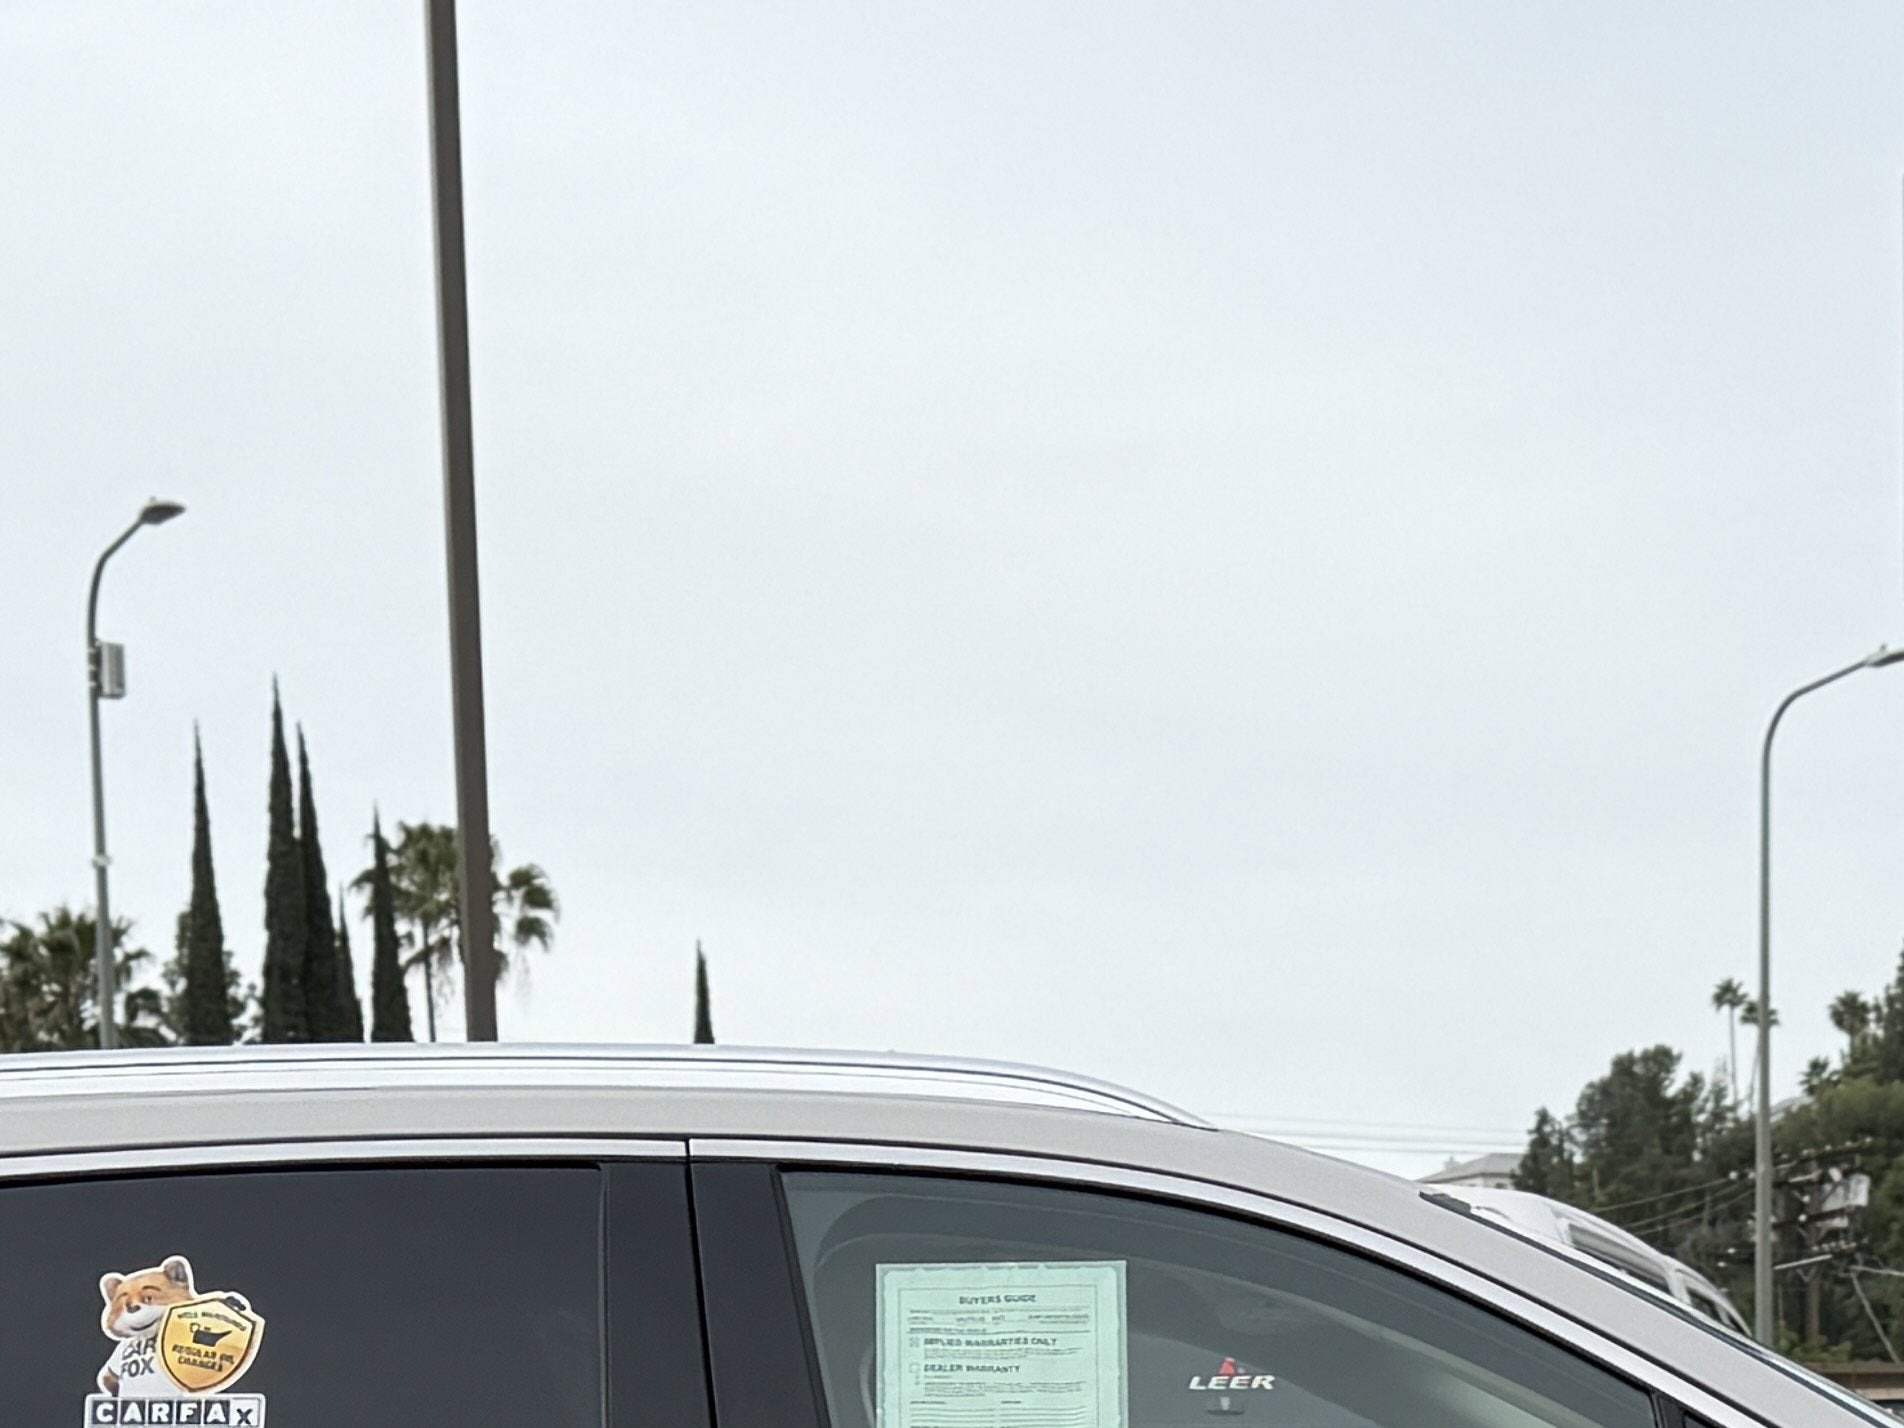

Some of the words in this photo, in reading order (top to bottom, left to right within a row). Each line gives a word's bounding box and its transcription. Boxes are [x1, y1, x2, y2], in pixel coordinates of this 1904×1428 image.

[120, 1356, 155, 1379] FOX
[1189, 1374, 1276, 1391] LEER
[96, 1402, 254, 1425] CARFAX
